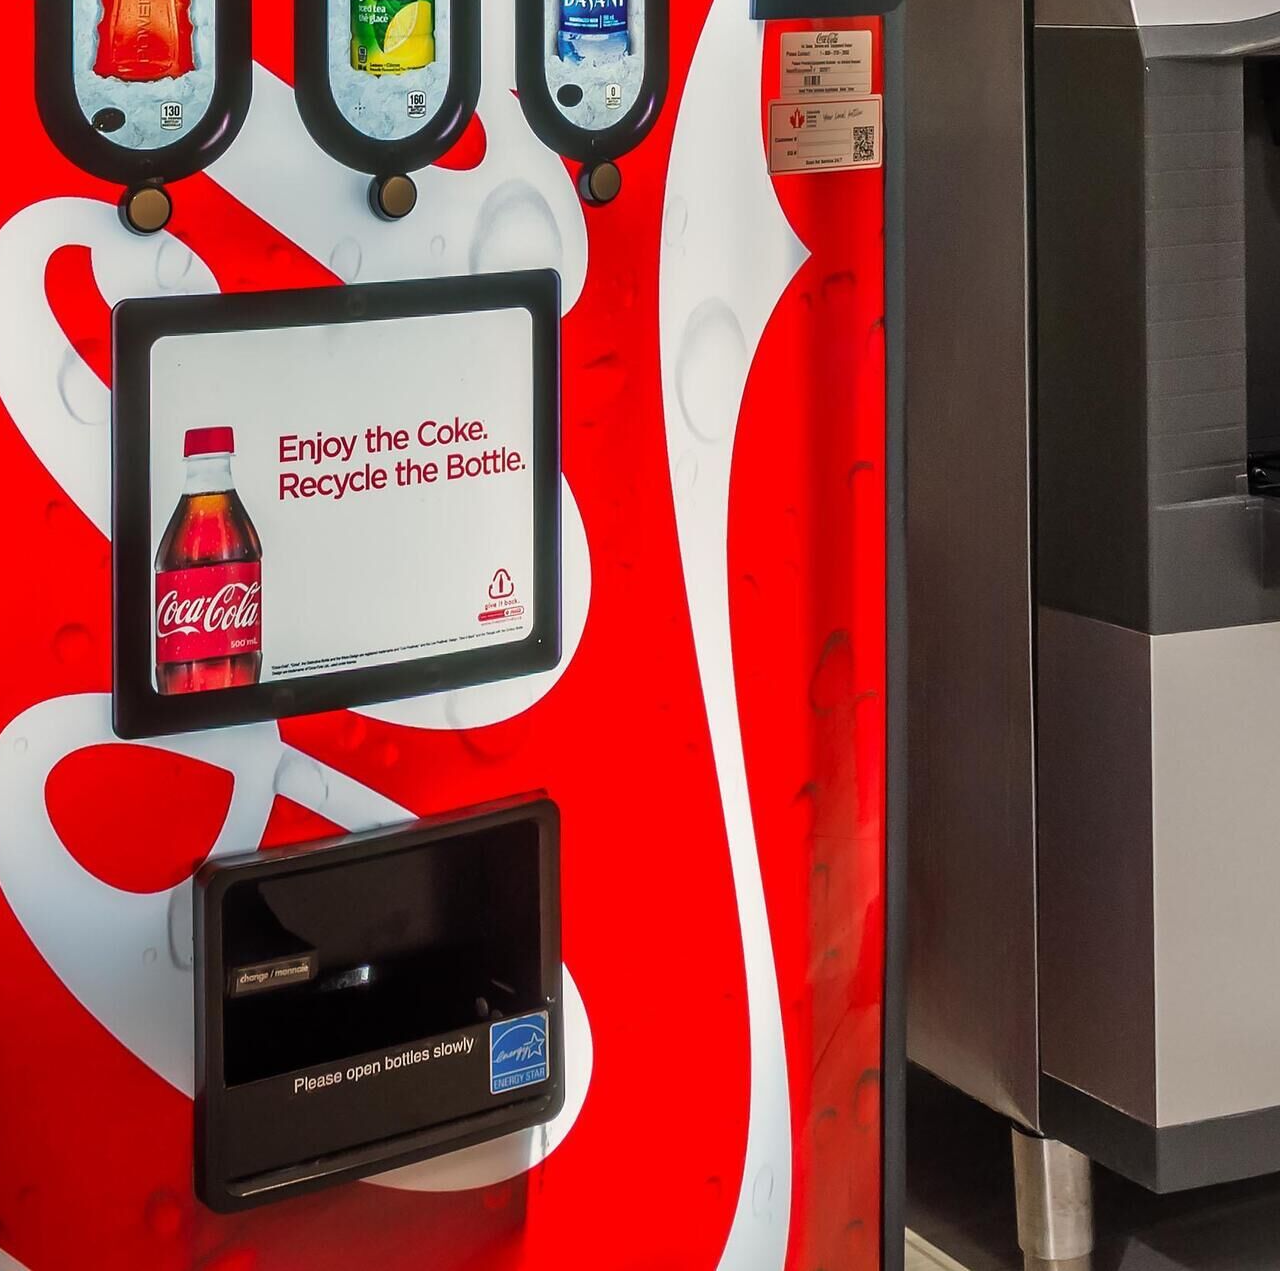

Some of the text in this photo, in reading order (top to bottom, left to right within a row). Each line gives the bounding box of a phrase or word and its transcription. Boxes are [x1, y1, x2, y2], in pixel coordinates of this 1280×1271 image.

[410, 94, 424, 105] 160
[611, 86, 616, 97] 0
[163, 105, 180, 117] 130
[279, 417, 488, 465] Enjoy the Coke.
[279, 446, 526, 501] Recycle the Bottle.
[157, 581, 261, 638] Coca-Cola
[230, 636, 258, 648] 500 mL
[240, 972, 269, 984] change
[294, 1036, 474, 1094] Please open bottles slowly
[494, 1067, 545, 1091] ENERGY STAR
